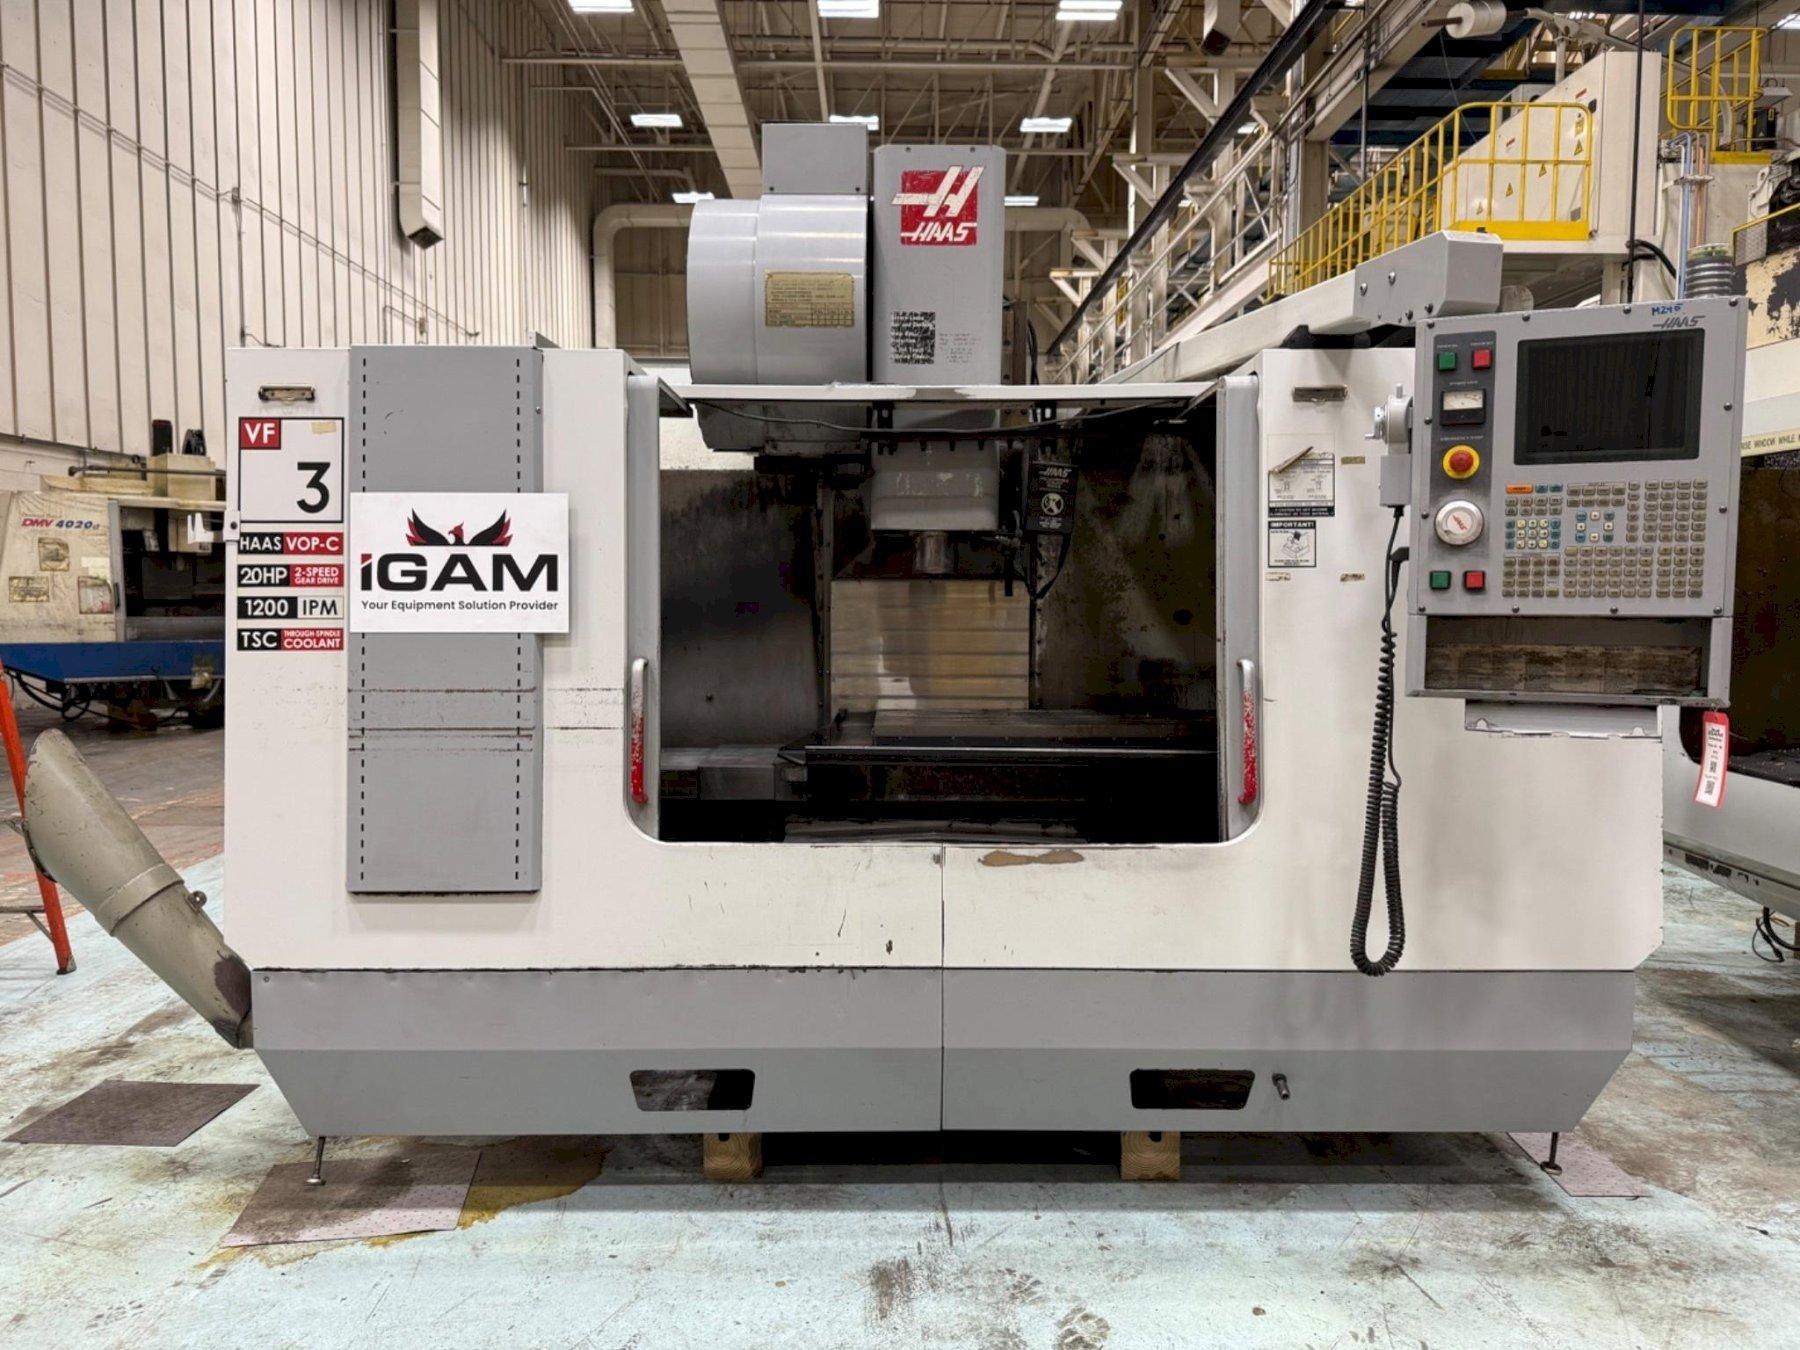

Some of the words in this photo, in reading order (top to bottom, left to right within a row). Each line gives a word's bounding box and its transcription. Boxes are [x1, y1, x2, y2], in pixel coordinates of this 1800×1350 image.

[900, 221, 977, 241] HAAS
[1652, 315, 1706, 328] HAAS
[243, 422, 276, 444] VF
[296, 461, 331, 514] 3
[22, 518, 54, 527] DMV
[240, 536, 281, 551] HAAS
[286, 536, 340, 551] VOP-C
[240, 566, 288, 585] 20HP
[294, 566, 339, 577] 2-SPEED
[294, 577, 315, 585] GEAR
[316, 577, 339, 585] DRIVE
[360, 553, 559, 592] iGAM
[245, 598, 289, 616] 1200
[302, 599, 338, 616] IPM
[361, 600, 388, 610] Your
[391, 599, 455, 613] Equipment
[458, 599, 506, 610] Solution
[509, 599, 559, 610] Provider
[241, 631, 278, 648] TSC
[283, 638, 341, 648] COOLANT
